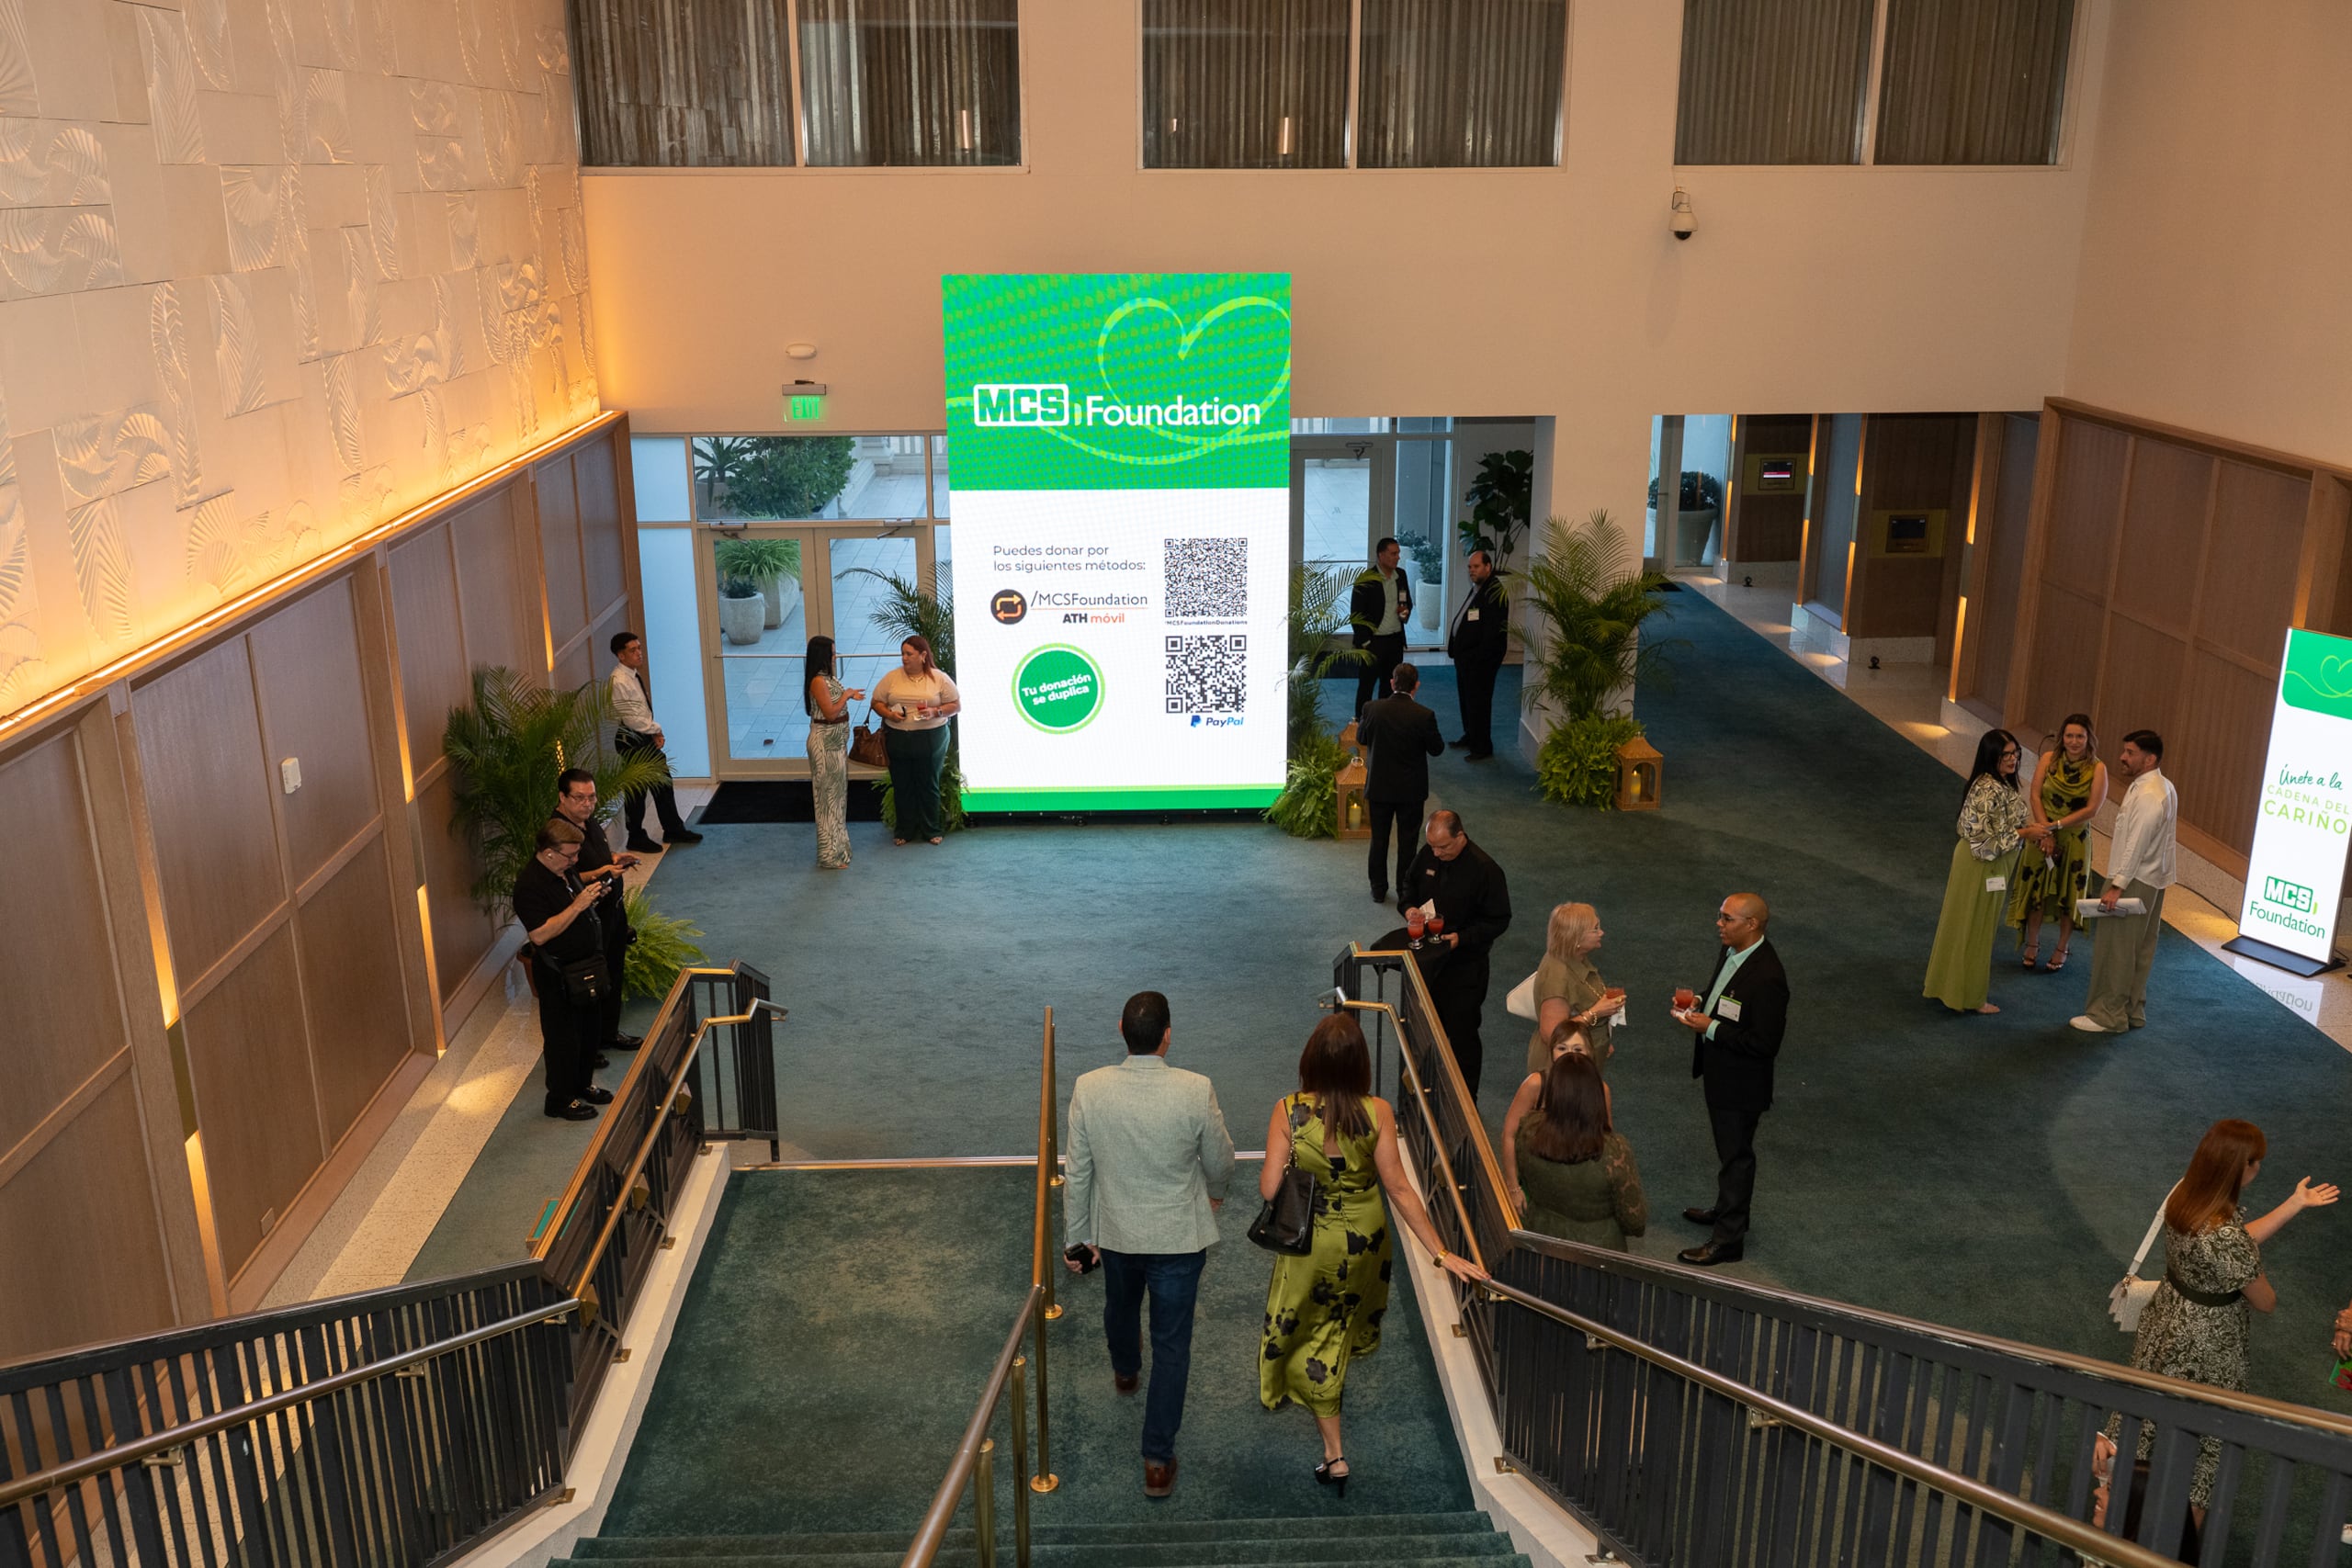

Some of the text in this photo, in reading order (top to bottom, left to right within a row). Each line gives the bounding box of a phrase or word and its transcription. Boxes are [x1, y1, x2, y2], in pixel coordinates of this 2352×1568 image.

[791, 397, 820, 420] EXIT
[976, 386, 1261, 426] MCS Foundation
[993, 545, 1109, 558] Puedes donar por
[993, 558, 1146, 573] los siguientes métodos:
[1030, 591, 1148, 607] /MCSFoundation
[1062, 613, 1125, 624] ATH móvil
[1022, 673, 1091, 697] Tu donación
[1032, 685, 1090, 705] se duplica
[1206, 716, 1244, 728] PayPal
[2279, 763, 2344, 791] Únete a la
[2267, 784, 2350, 816] CADENA DEL
[2264, 799, 2347, 835] CARIÑO
[2265, 876, 2312, 912] MCS
[2249, 900, 2325, 939] Foundation
